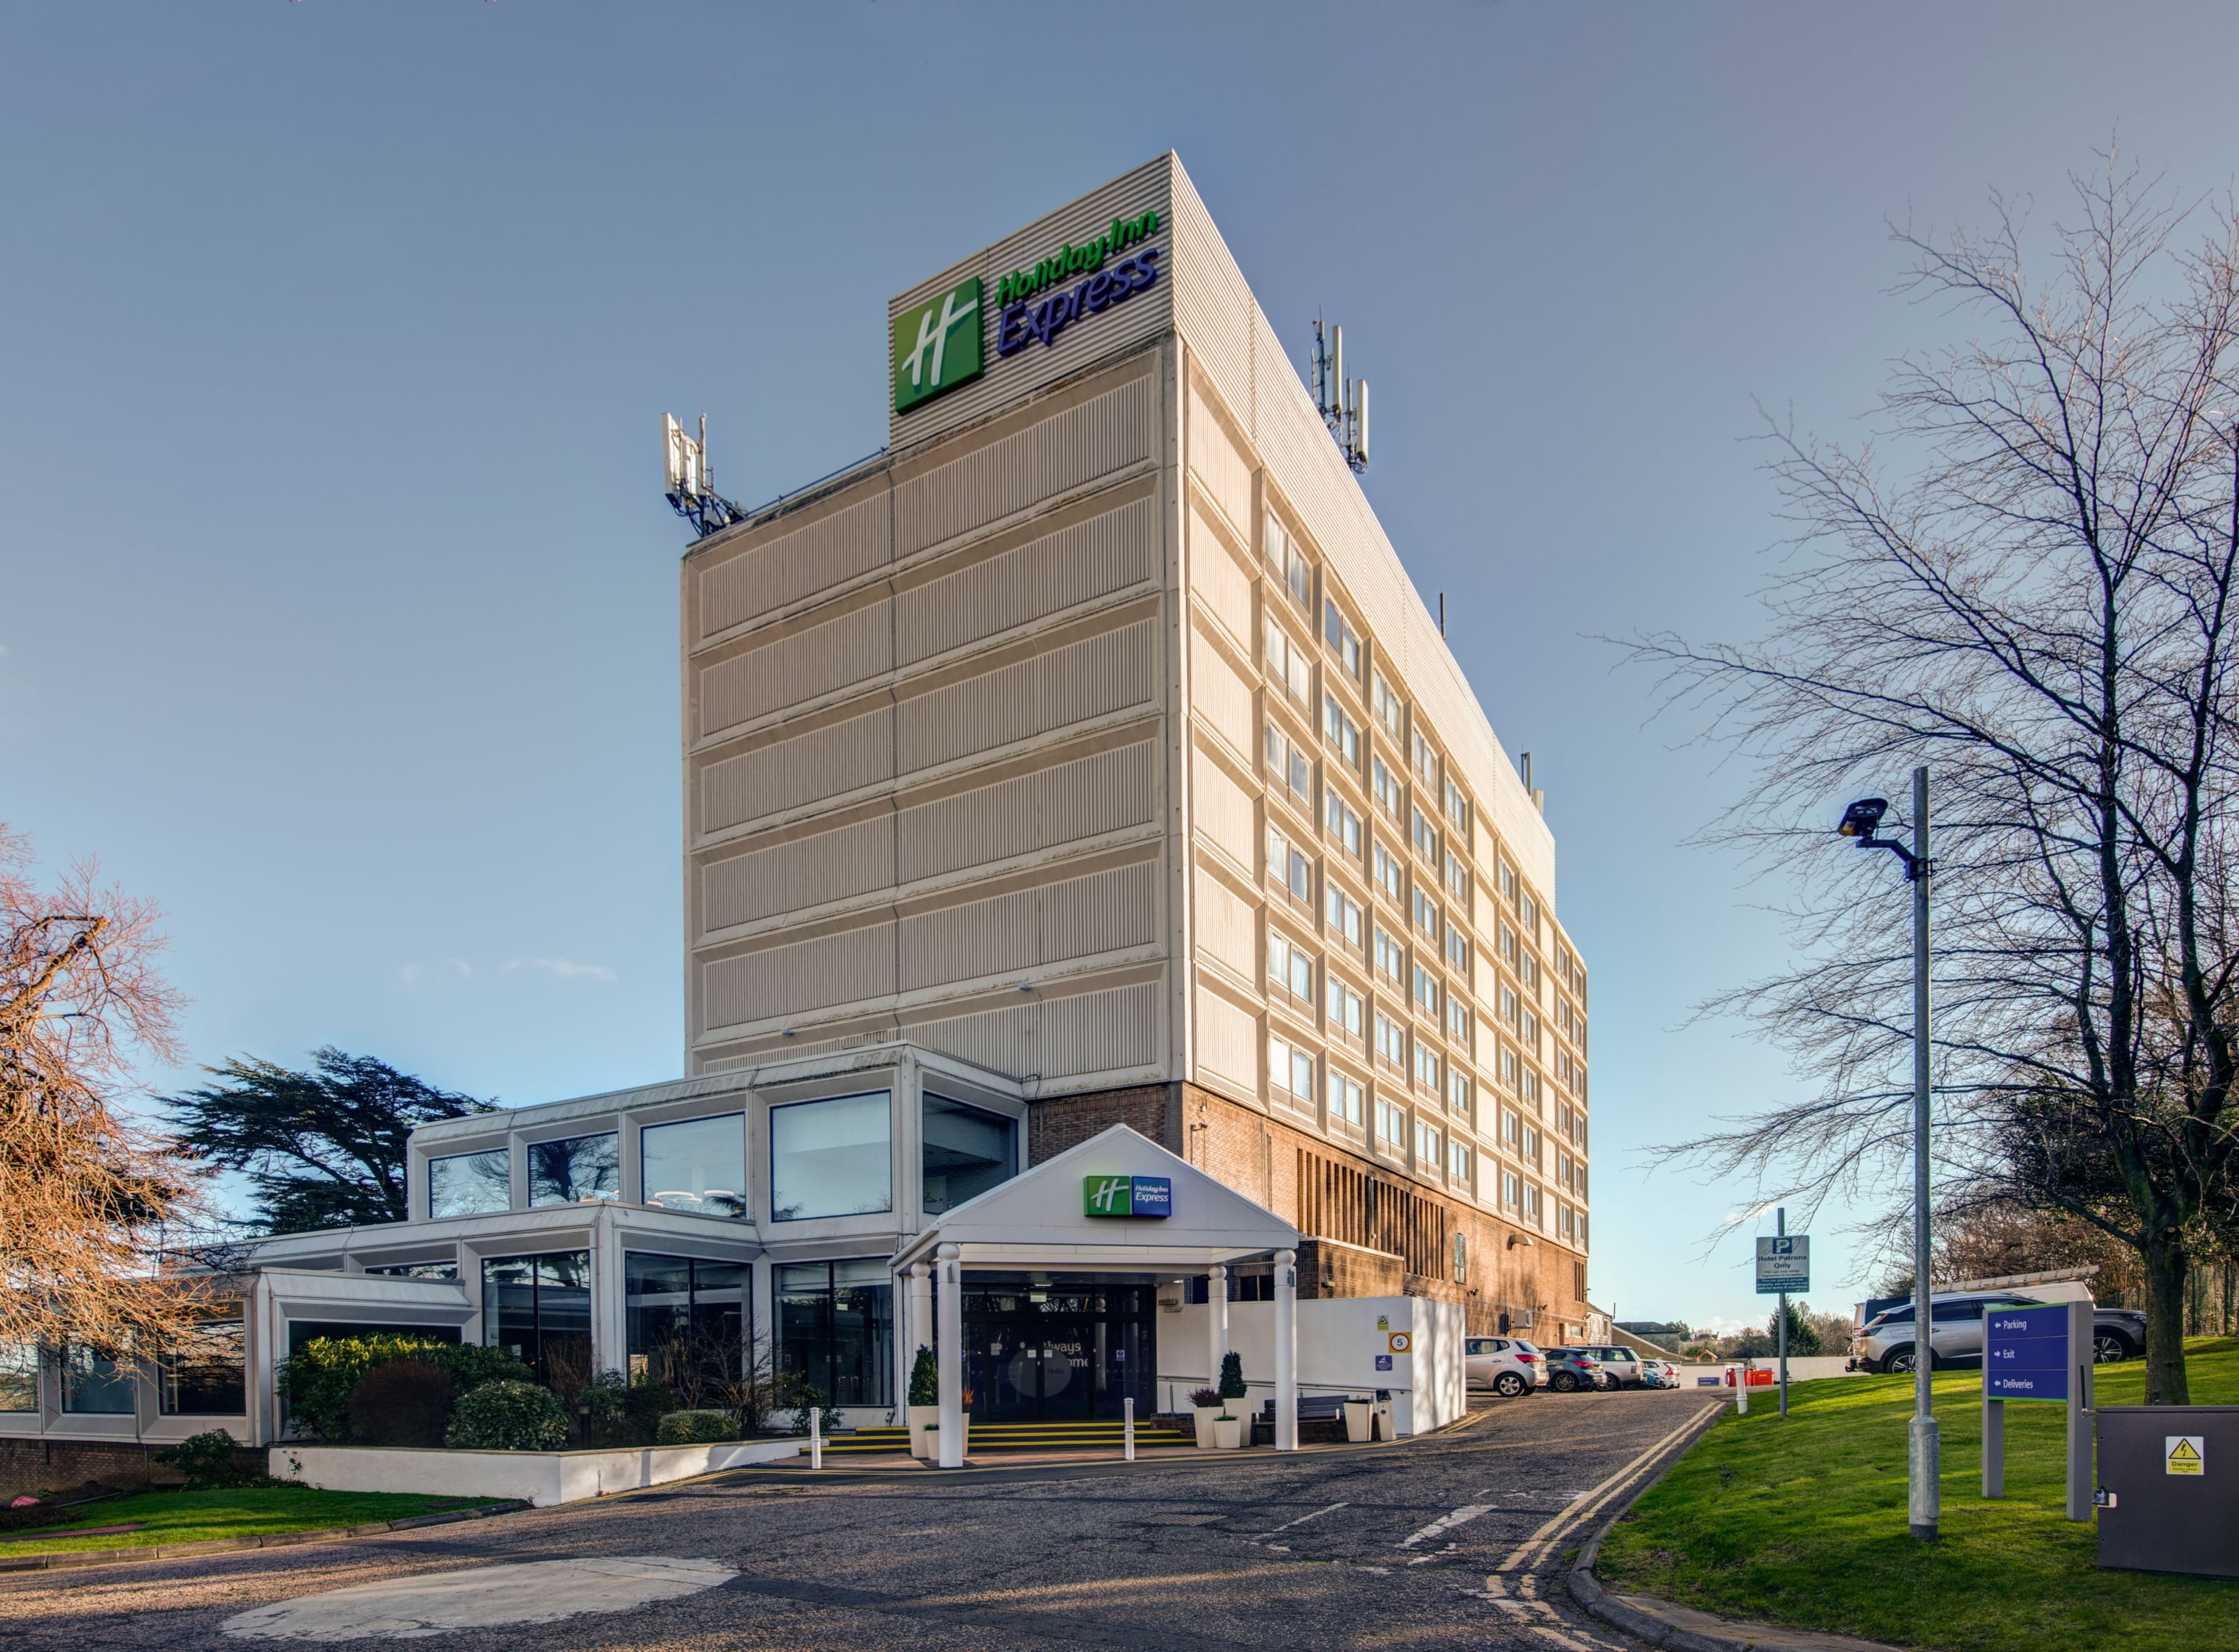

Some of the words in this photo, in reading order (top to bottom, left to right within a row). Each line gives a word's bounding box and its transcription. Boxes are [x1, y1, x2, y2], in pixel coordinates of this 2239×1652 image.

[995, 236, 1107, 310] Holiday
[1108, 210, 1159, 252] Inn
[996, 247, 1159, 357] Express
[1135, 1184, 1159, 1193] Holiday
[1136, 1192, 1168, 1203] Express
[1776, 1240, 1790, 1253] P
[2003, 1320, 2027, 1331] Parking
[2003, 1349, 2015, 1359] Exit
[2003, 1379, 2033, 1389] Deliveries
